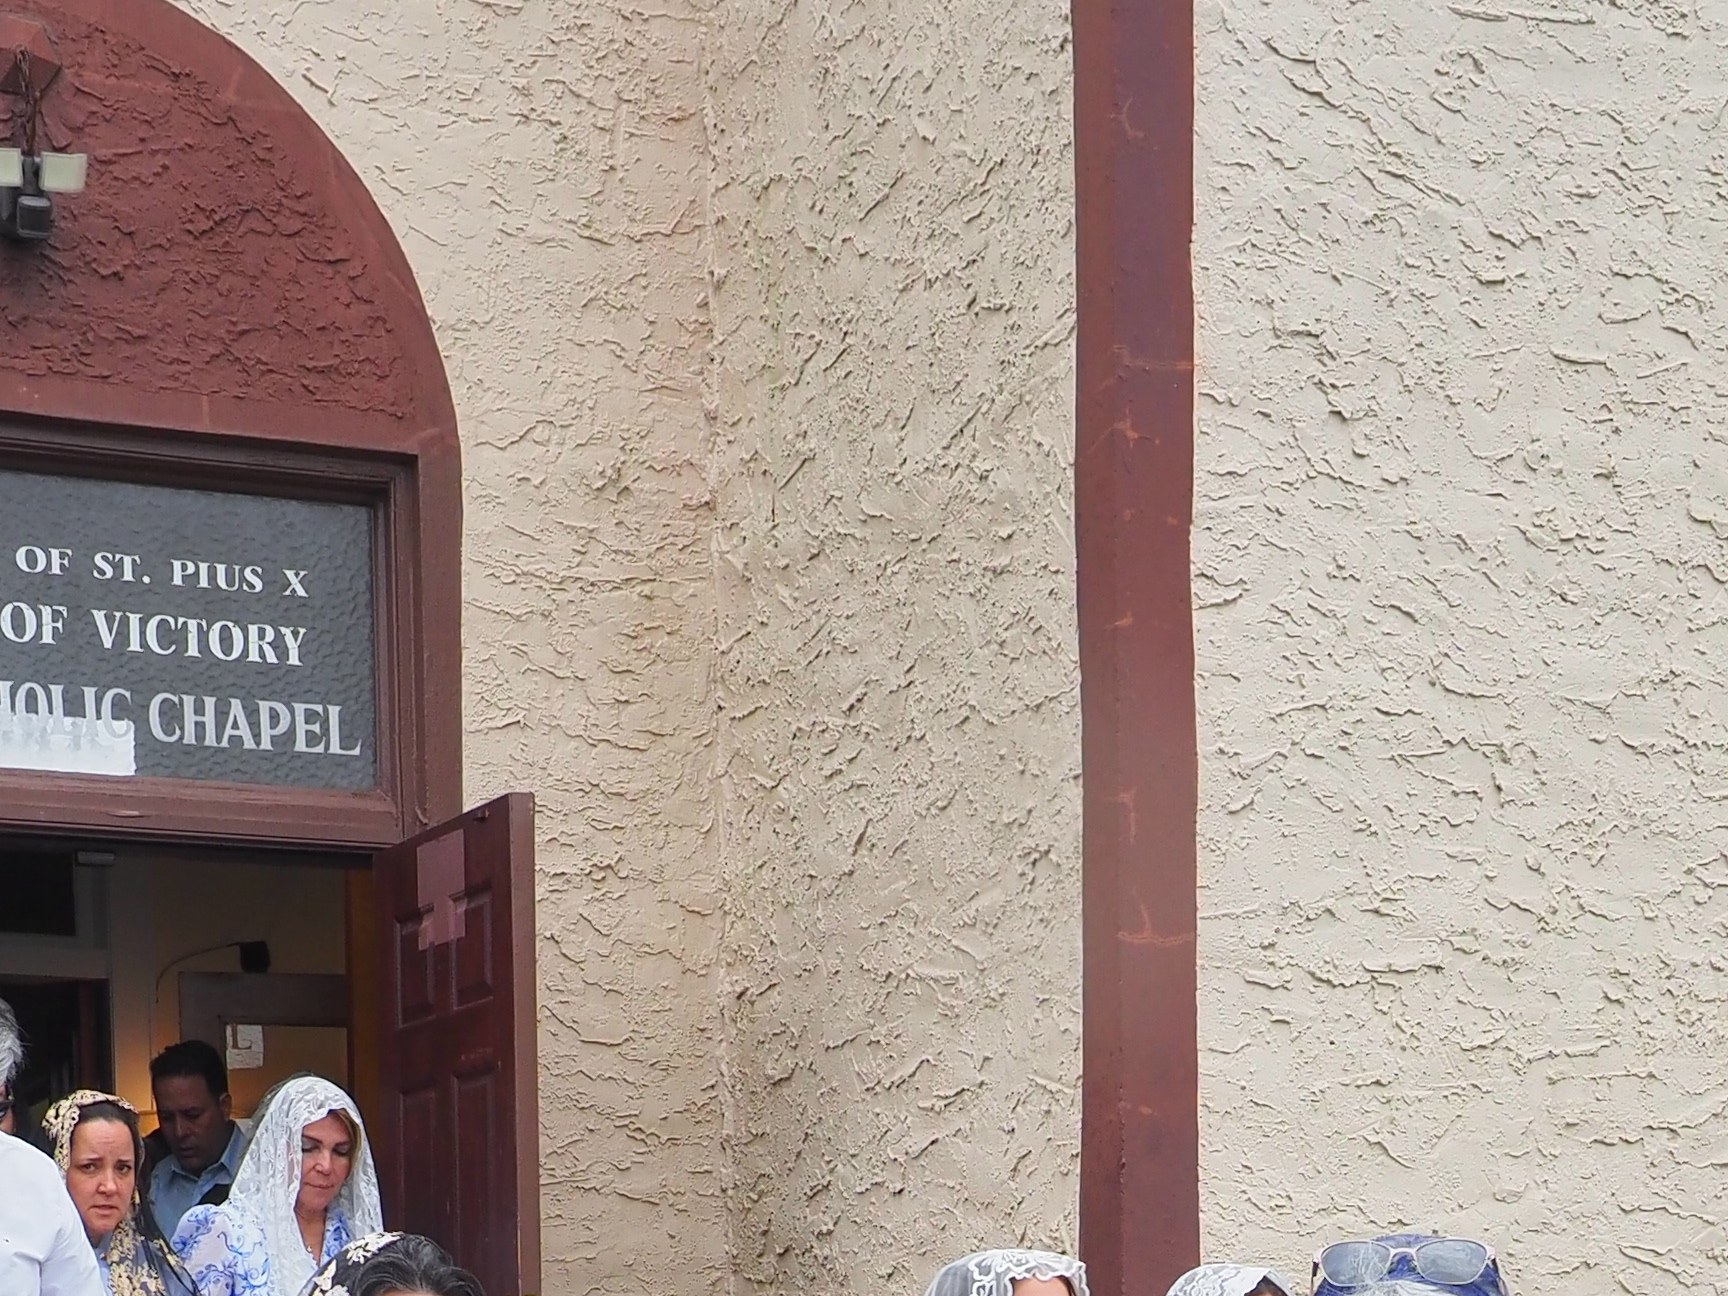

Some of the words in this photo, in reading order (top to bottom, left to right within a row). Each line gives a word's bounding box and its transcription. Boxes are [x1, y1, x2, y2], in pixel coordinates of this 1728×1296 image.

[15, 545, 73, 576] OF
[92, 551, 152, 585] ST.
[170, 558, 264, 594] PIUS
[282, 568, 310, 598] X
[0, 601, 68, 645] OF
[90, 608, 307, 667] VICTORY
[148, 691, 363, 757] CHAPEL
